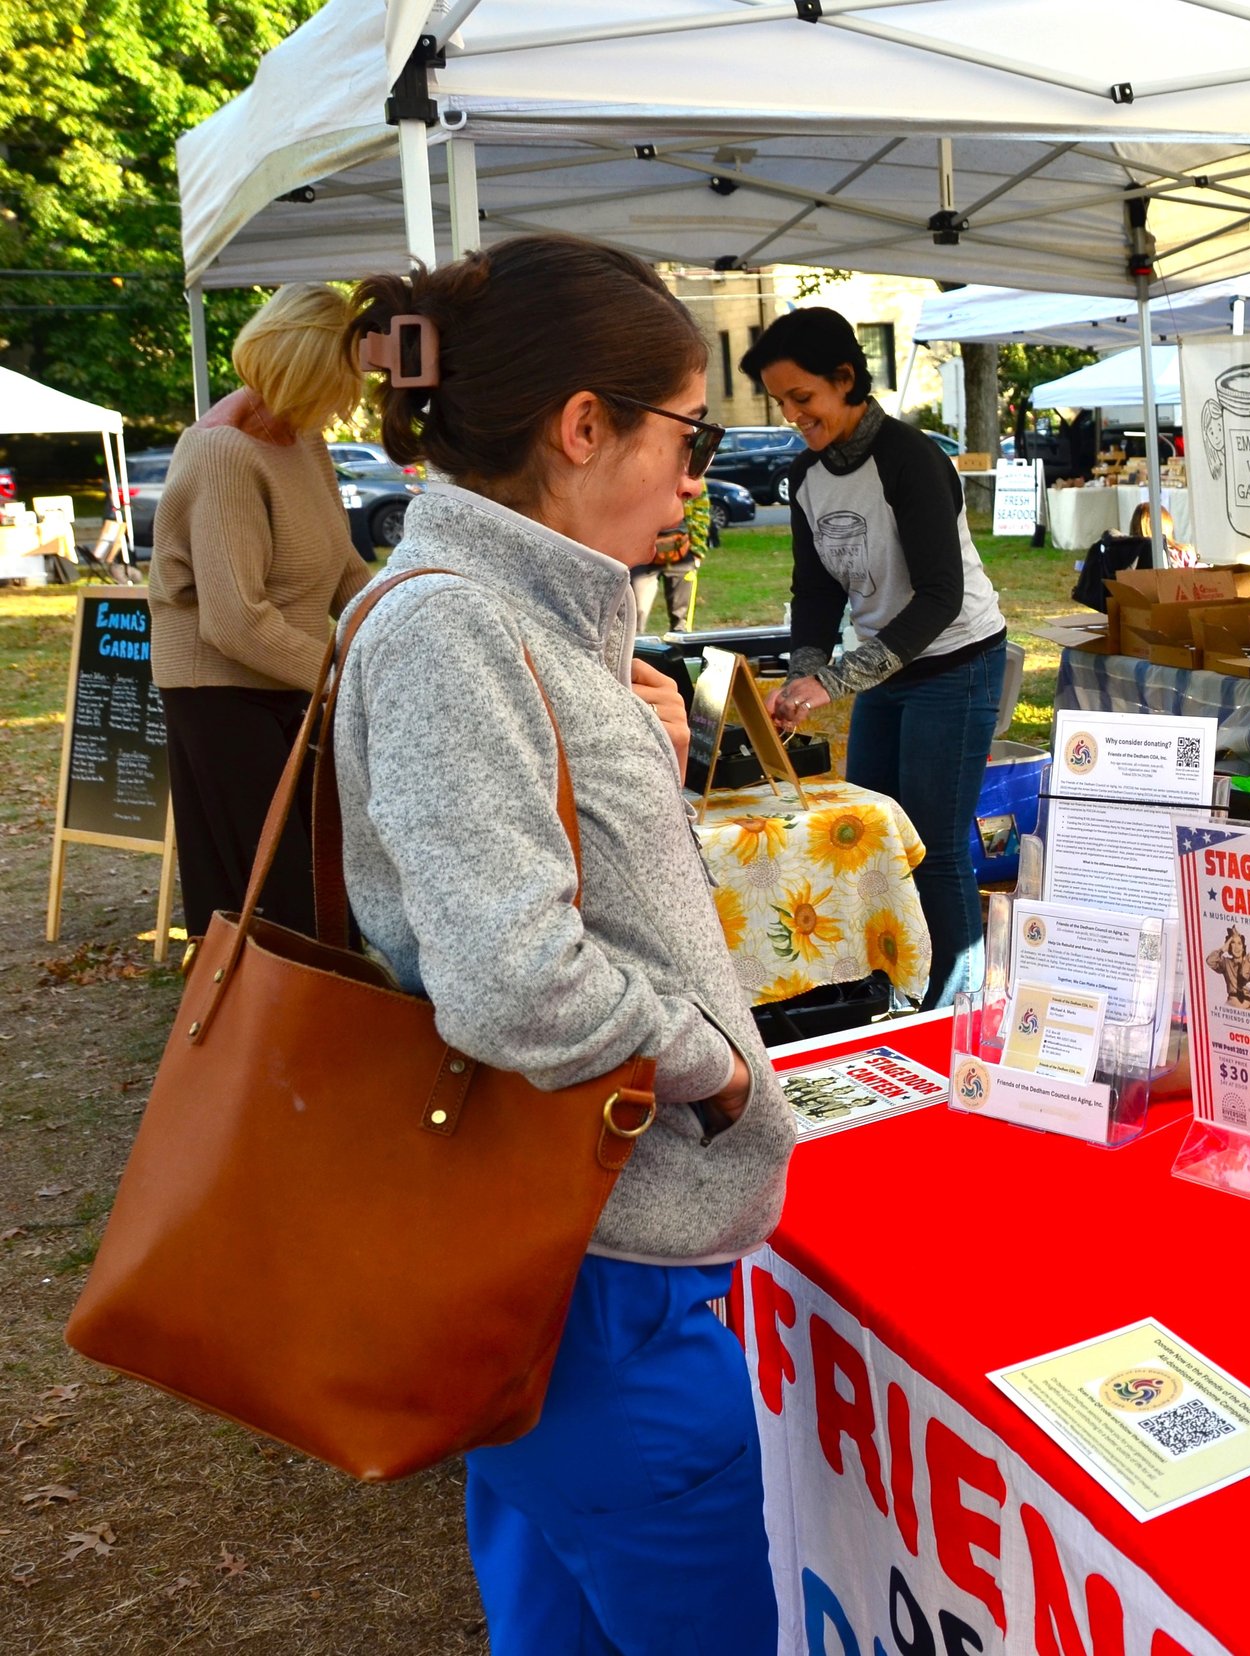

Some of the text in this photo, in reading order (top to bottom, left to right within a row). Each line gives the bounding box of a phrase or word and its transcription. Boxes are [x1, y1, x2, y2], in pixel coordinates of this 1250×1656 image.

[1105, 737, 1172, 750] Why consider donating?
[1209, 912, 1239, 923] MUSICAL
[1221, 1013, 1245, 1024] FRIENDS
[846, 1067, 908, 1098] CANTEEN
[864, 1057, 911, 1079] STAGE
[903, 1074, 943, 1095] DOOR
[1220, 1063, 1248, 1083] $30
[996, 1079, 1015, 1088] Friends
[1029, 1086, 1050, 1096] Dedham
[1051, 1091, 1070, 1100] Council
[1078, 1097, 1093, 1107] Aging,
[1093, 1100, 1103, 1108] Inc.
[1154, 1339, 1174, 1355] Donate
[1173, 1353, 1187, 1364] Now
[1186, 1361, 1193, 1370] to
[1191, 1365, 1203, 1376] the
[1202, 1374, 1224, 1391] Friends
[1228, 1391, 1240, 1404] the
[1194, 1380, 1221, 1402] Welcome
[751, 1264, 1217, 1656] FRIEN
